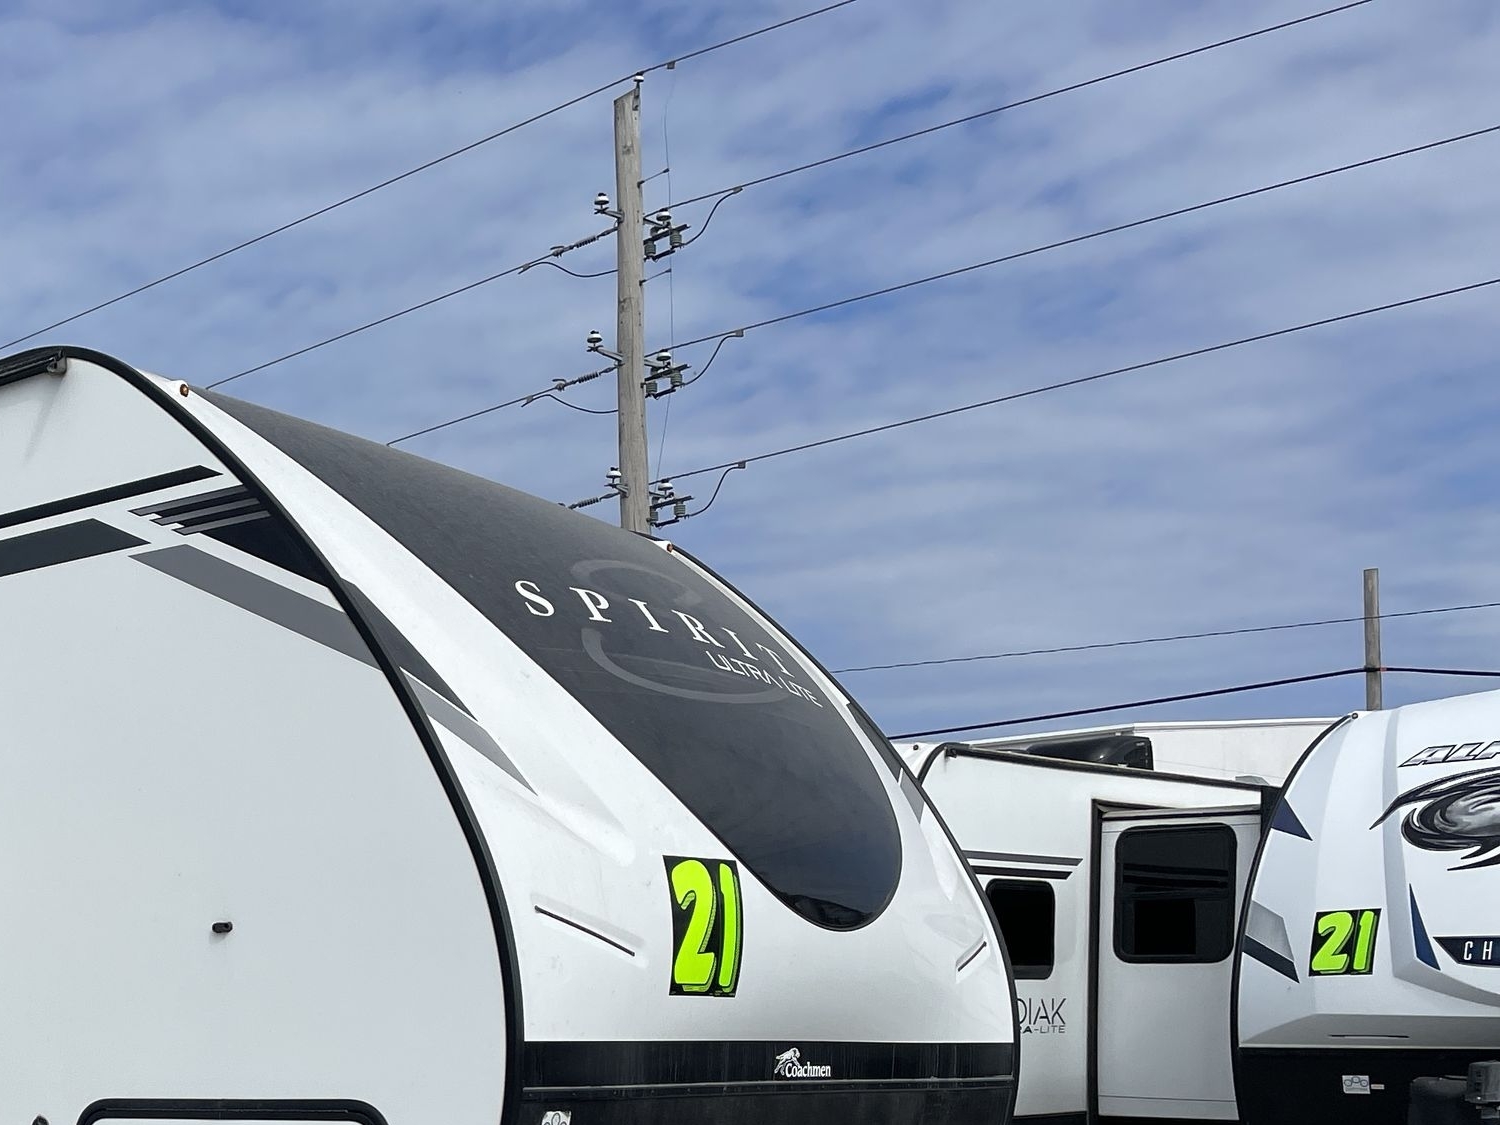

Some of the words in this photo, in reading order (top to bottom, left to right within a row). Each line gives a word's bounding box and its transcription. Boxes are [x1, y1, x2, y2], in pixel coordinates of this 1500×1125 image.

[514, 579, 796, 678] SPIRIT
[706, 650, 783, 689] ULTRA
[780, 679, 824, 708] LITE
[670, 859, 742, 993] 21
[1311, 910, 1378, 975] 21
[785, 1061, 831, 1078] Coachmen
